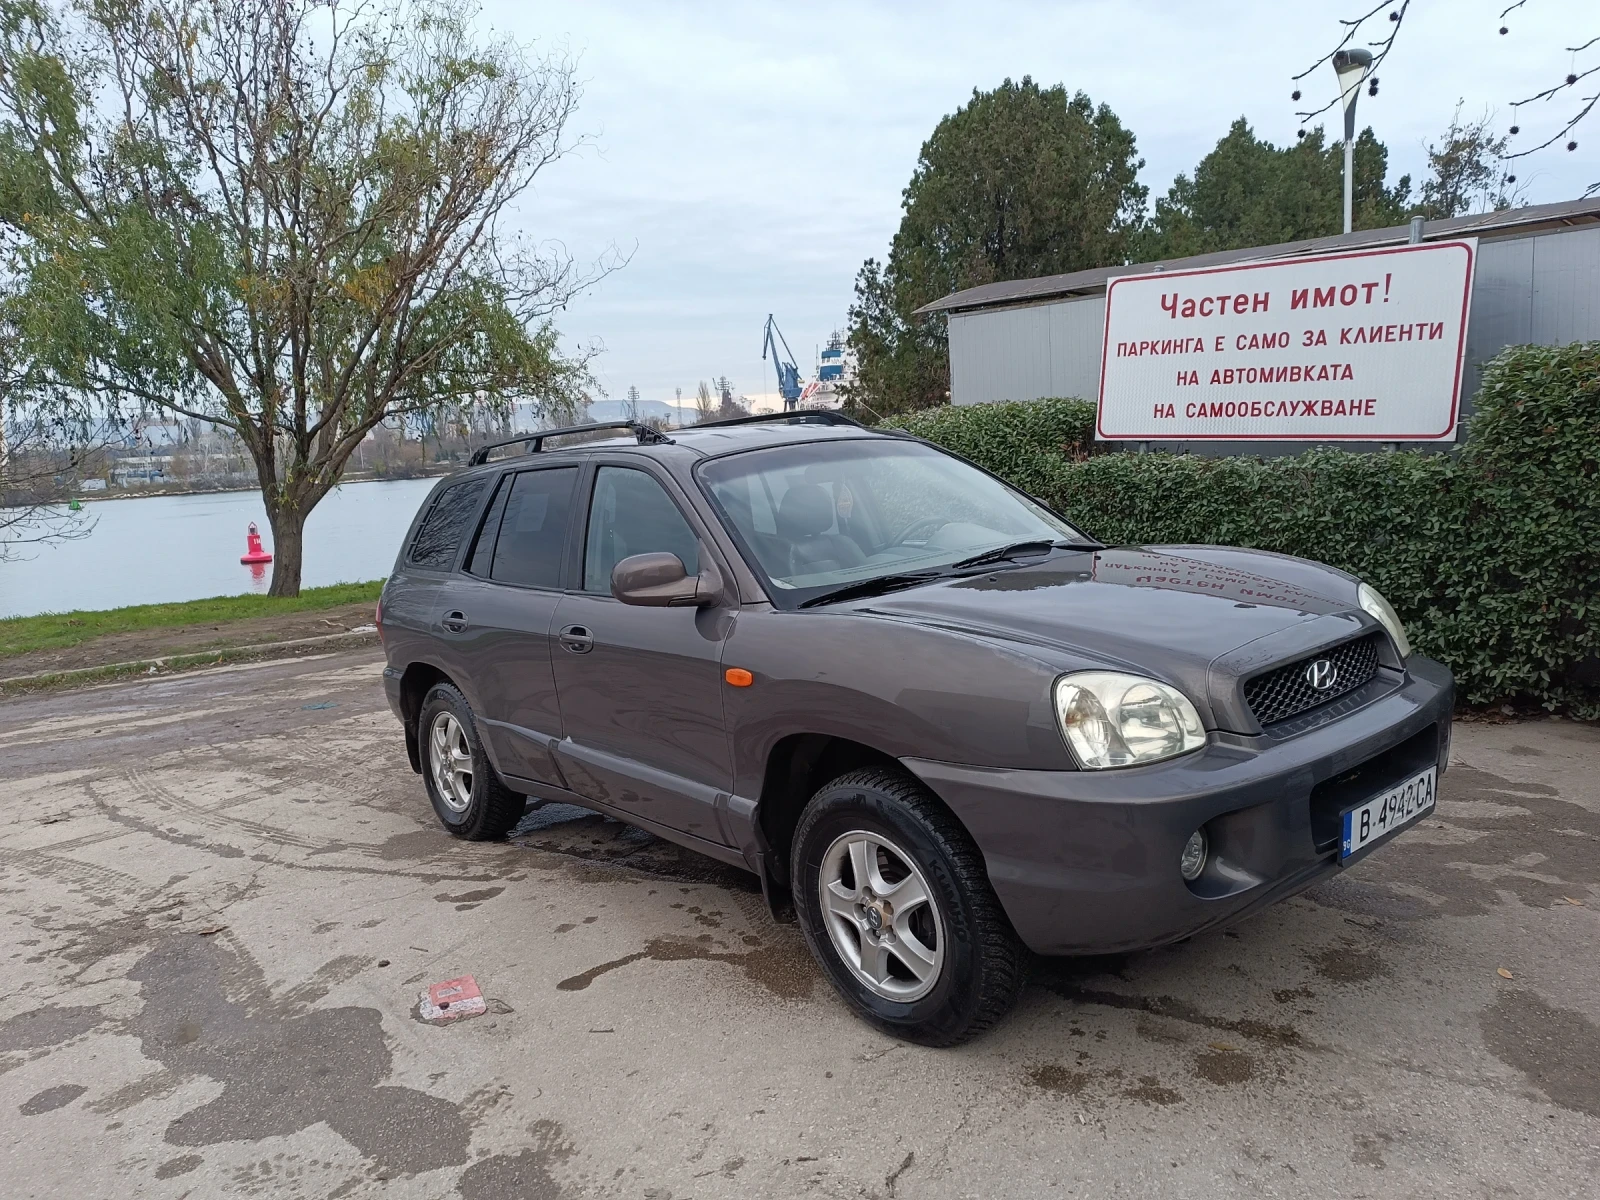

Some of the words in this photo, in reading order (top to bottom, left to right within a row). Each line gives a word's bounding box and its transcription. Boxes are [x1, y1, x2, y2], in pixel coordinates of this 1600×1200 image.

[1160, 292, 1270, 319] Частен
[1291, 273, 1393, 310] имот!
[1117, 337, 1205, 358] ПАРКИНГА
[1215, 336, 1226, 352] Е
[1236, 331, 1291, 351] САМО
[1302, 329, 1329, 347] ЗА
[1339, 321, 1445, 345] КЛИЕНТИ
[1176, 369, 1200, 387] НА
[1210, 363, 1355, 385] АВТОМИВКАТА
[1153, 403, 1177, 419] НА
[1185, 398, 1377, 418] САМООБСЛУЖВАНЕ
